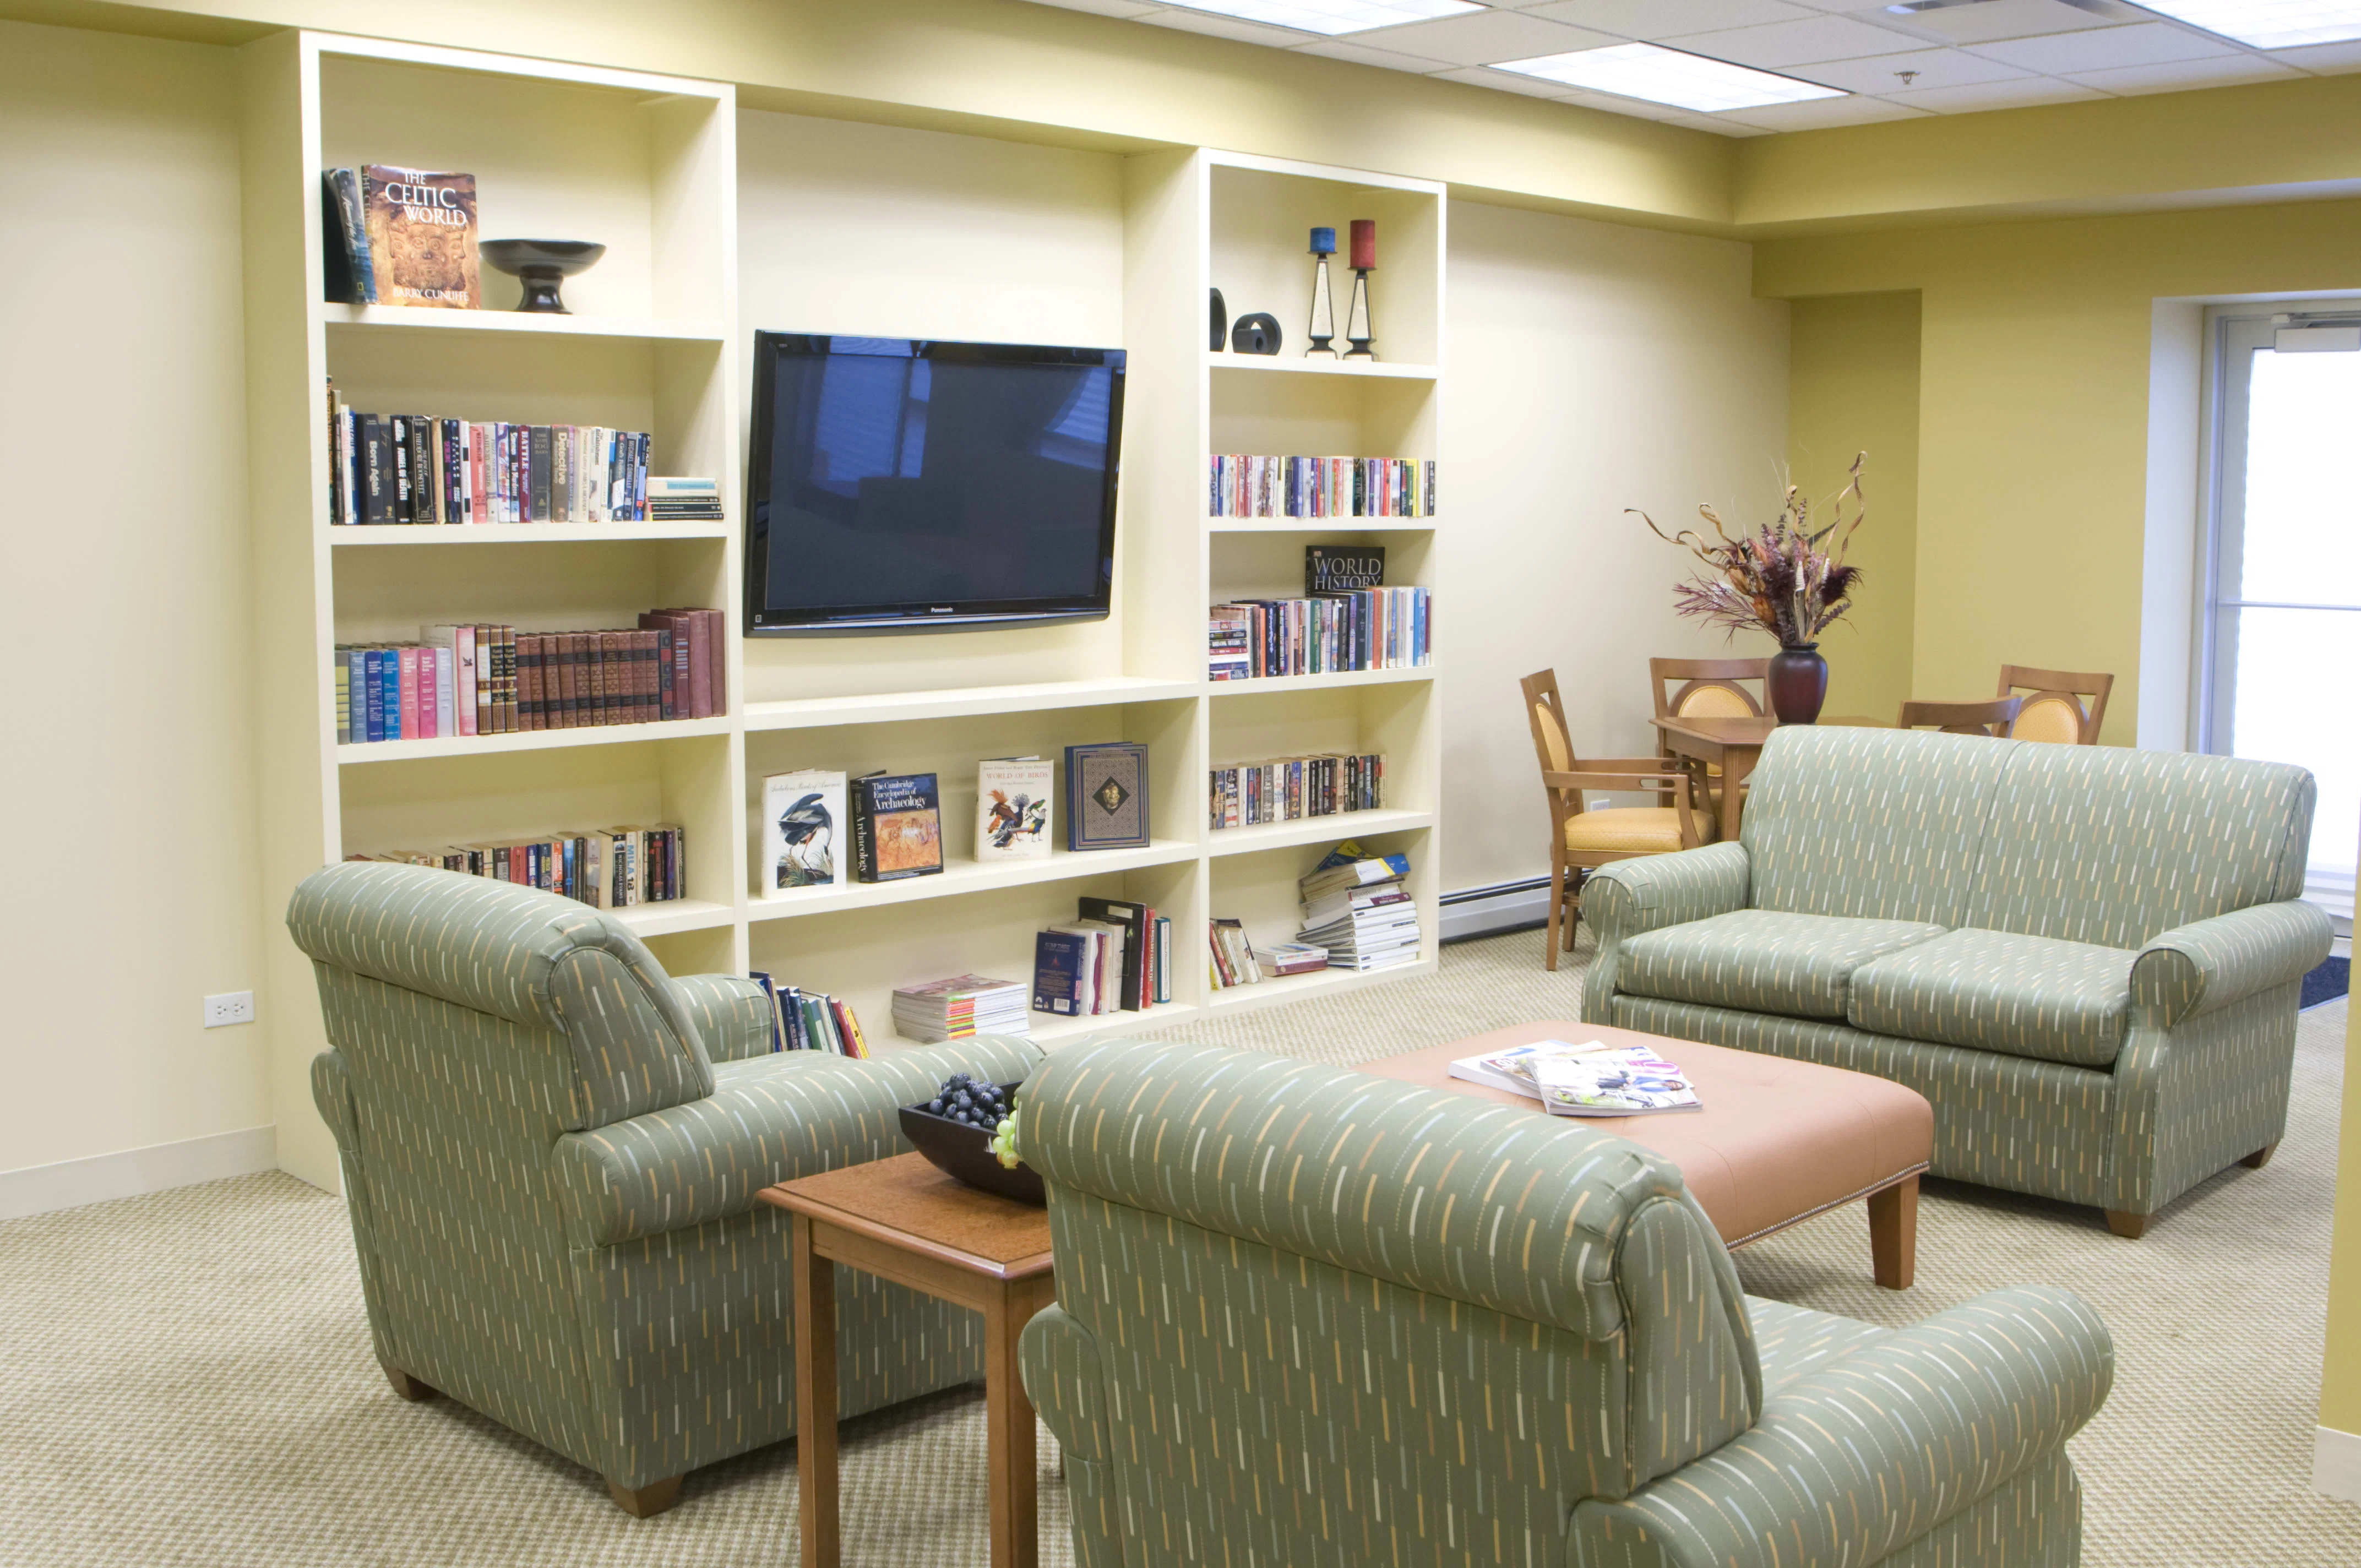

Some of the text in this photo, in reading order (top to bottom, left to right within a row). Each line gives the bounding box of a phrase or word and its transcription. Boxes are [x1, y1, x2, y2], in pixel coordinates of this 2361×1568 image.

[362, 171, 371, 192] THE
[404, 171, 427, 185] THE
[385, 183, 457, 209] CELTIC
[403, 205, 467, 226] WORLD
[393, 287, 470, 302] BARRY CUNLIFFE
[521, 431, 530, 469] BATTLE
[558, 432, 568, 485] Detective
[369, 441, 380, 497] Born Again
[397, 447, 408, 501] ANGEL OF DEATH
[1314, 558, 1381, 575] WORLD
[1314, 575, 1381, 590] HISTORY
[872, 779, 914, 791] The Cambridge
[873, 786, 917, 799] Encyclopedia of
[873, 795, 927, 811] Archaeology
[856, 814, 869, 872] Archaeology
[627, 876, 635, 891] 18
